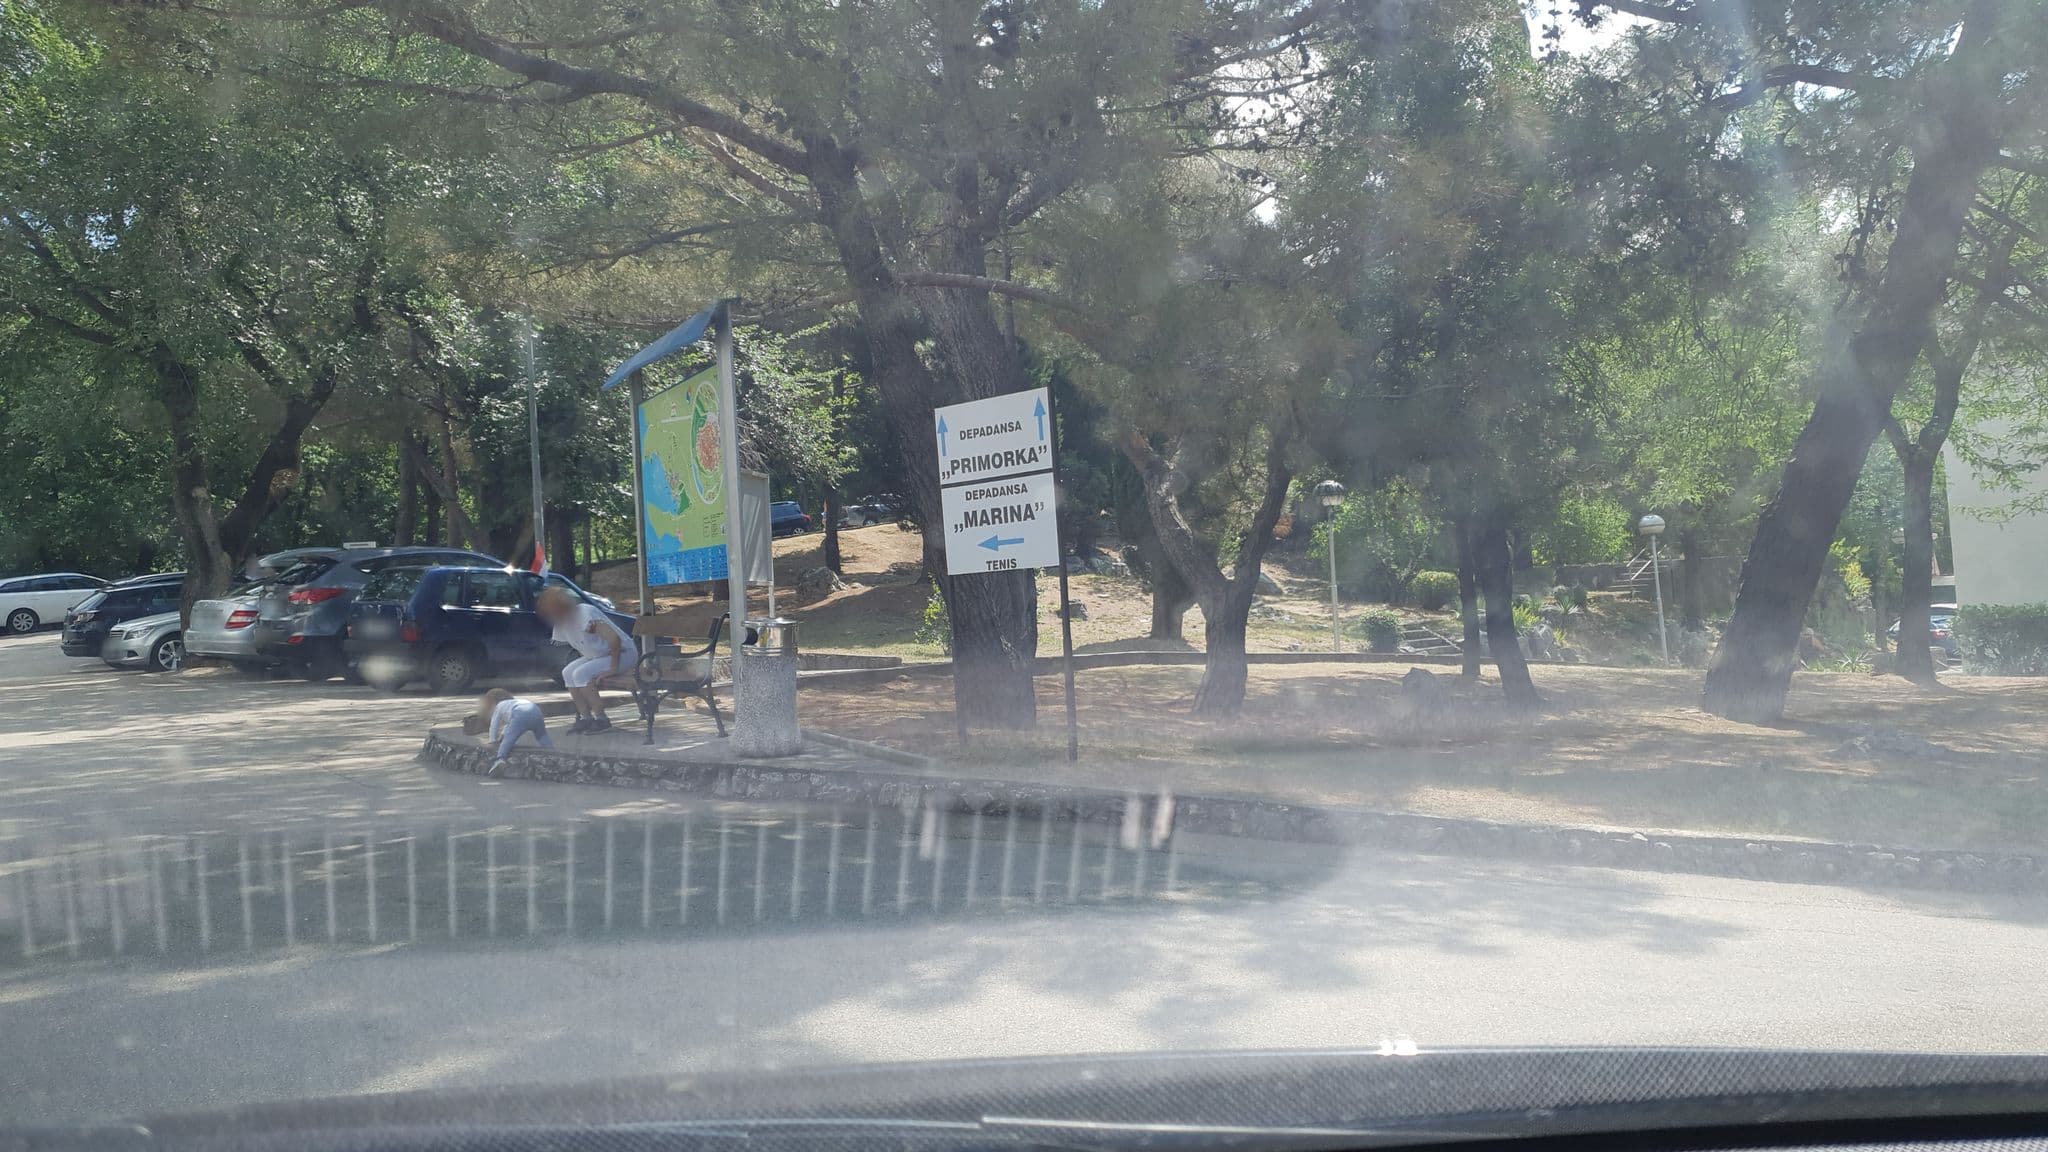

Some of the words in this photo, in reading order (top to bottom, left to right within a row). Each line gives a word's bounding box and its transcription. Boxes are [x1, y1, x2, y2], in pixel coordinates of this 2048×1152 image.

[959, 420, 1022, 440] DEPADANSA
[965, 483, 1028, 501] DEPADANSA
[986, 559, 1017, 571] TENIS
